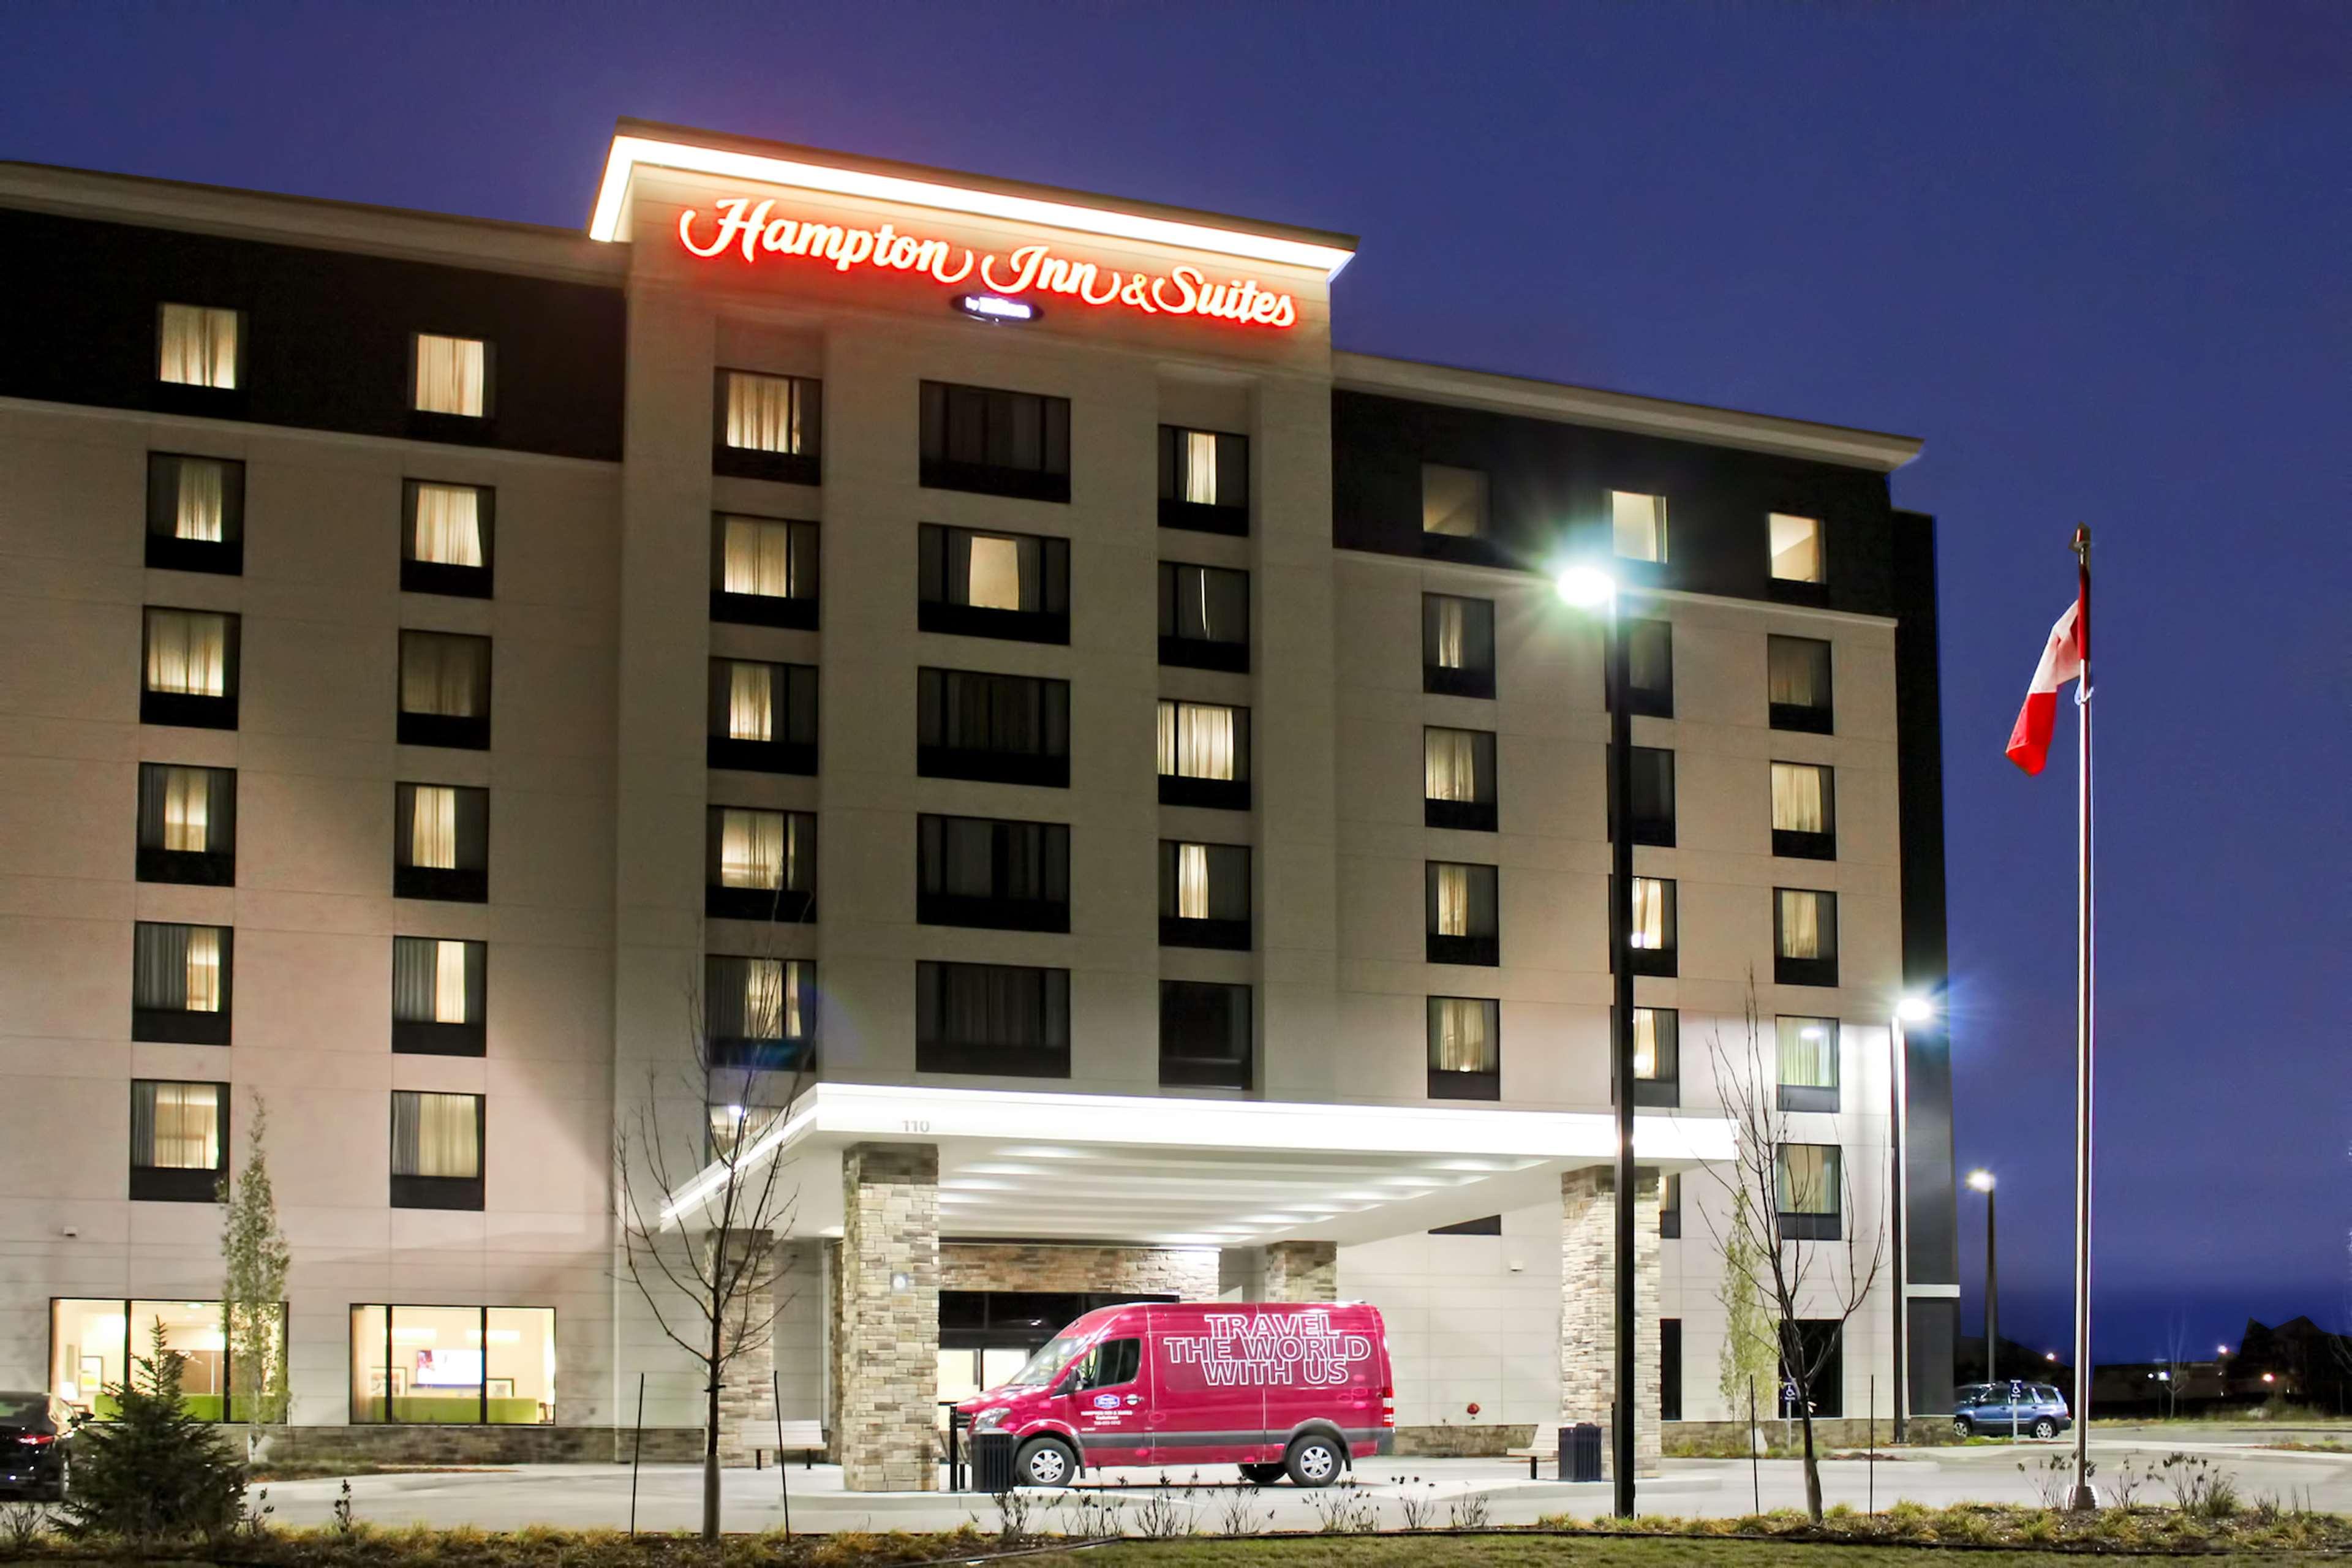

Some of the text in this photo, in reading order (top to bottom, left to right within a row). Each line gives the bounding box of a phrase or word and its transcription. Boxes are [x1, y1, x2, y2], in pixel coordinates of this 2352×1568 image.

[679, 198, 973, 283] Hampton
[981, 246, 1121, 304] Inn
[1152, 266, 1295, 327] Suites
[902, 1120, 930, 1133] 110
[1204, 1313, 1341, 1340] TRAVEL
[1164, 1335, 1371, 1363] THE WORLD
[1200, 1359, 1349, 1386] WITH US
